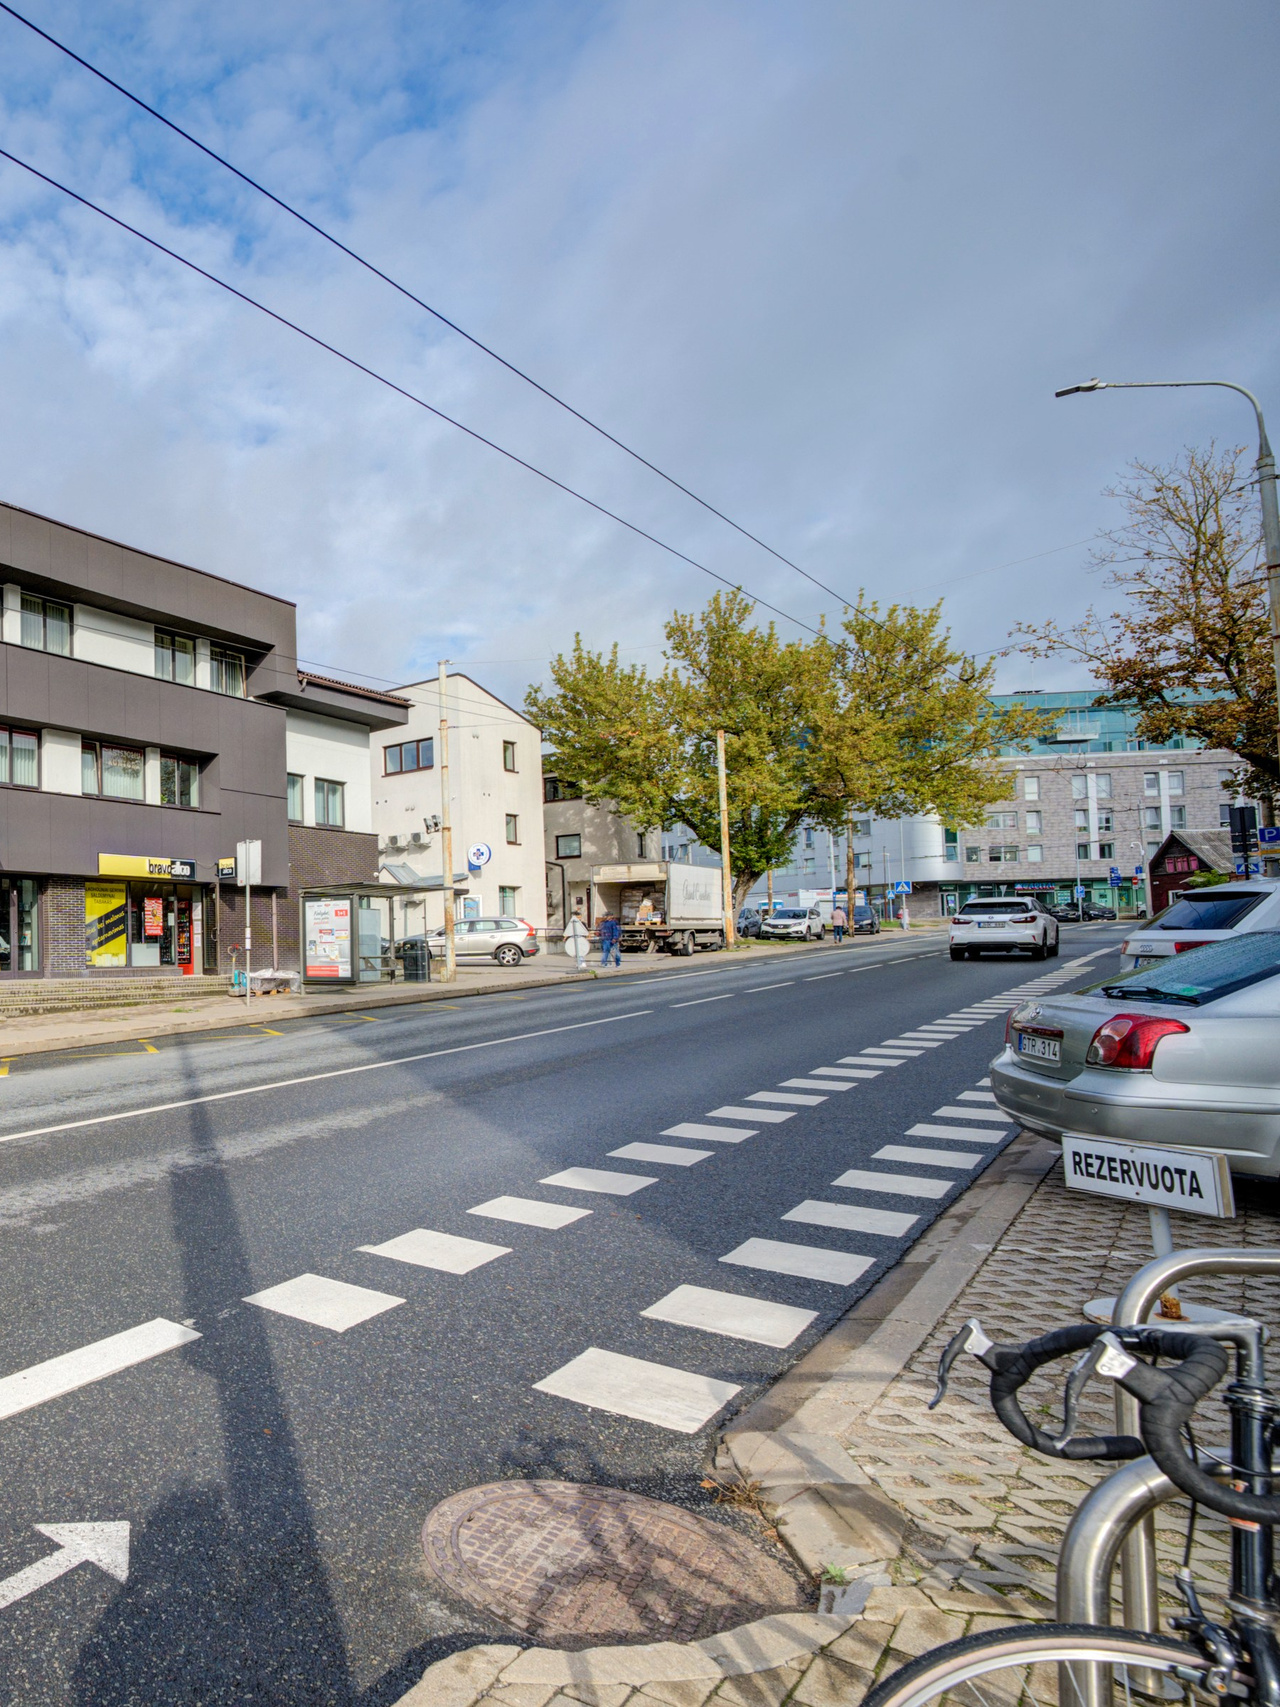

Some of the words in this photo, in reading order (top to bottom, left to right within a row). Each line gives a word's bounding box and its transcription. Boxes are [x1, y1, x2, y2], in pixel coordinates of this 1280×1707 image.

[1264, 828, 1278, 841] P
[1022, 1036, 1036, 1053] GTR
[1040, 1041, 1058, 1058] 314
[1072, 1150, 1204, 1199] REZERVUOTA
